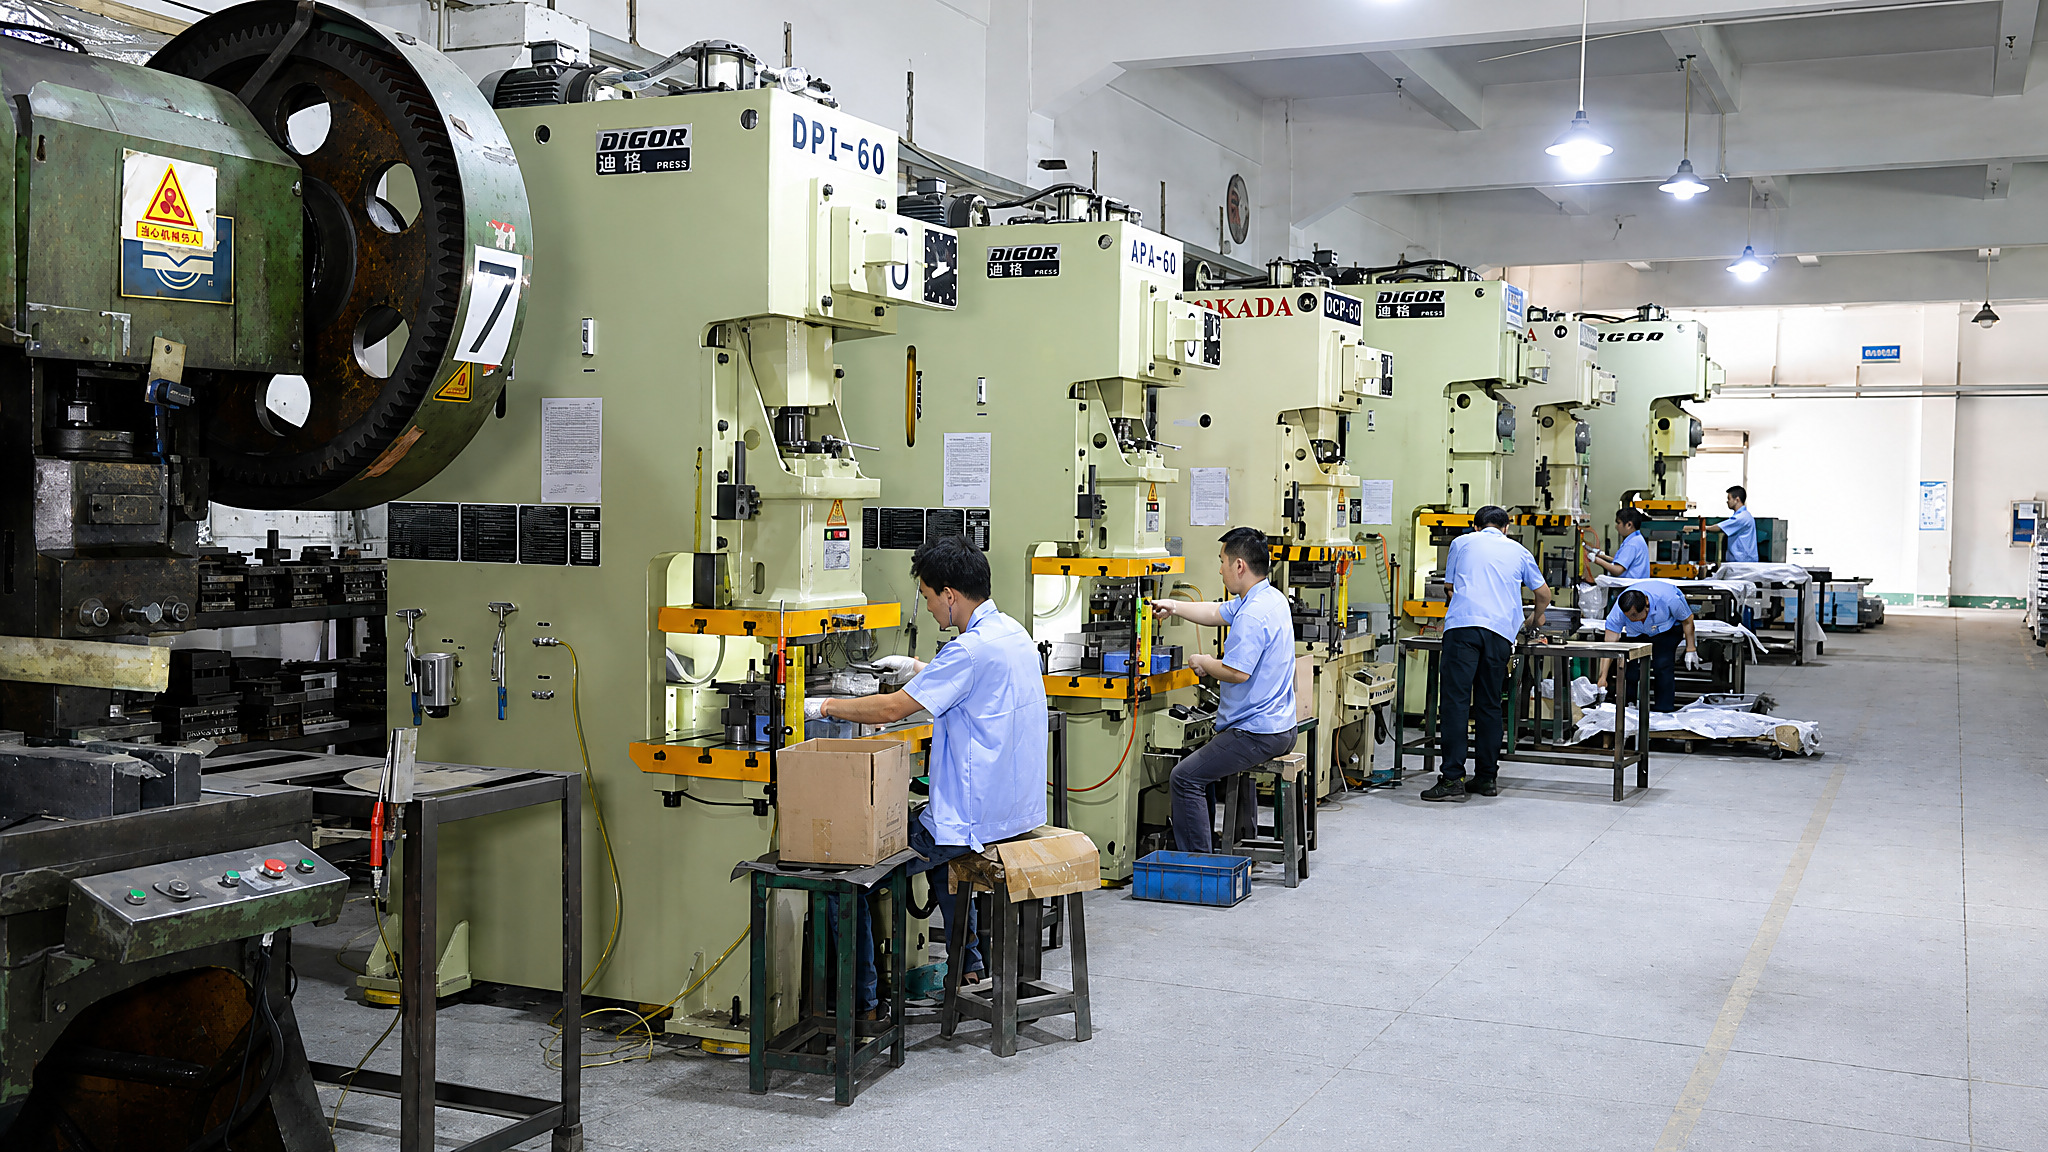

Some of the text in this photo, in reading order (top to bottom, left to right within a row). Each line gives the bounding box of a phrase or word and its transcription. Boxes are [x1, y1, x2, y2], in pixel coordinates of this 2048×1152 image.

[657, 160, 686, 170] PRESS
[793, 113, 884, 175] DPI-60
[1131, 240, 1176, 275] APA-60
[469, 260, 516, 353] 7
